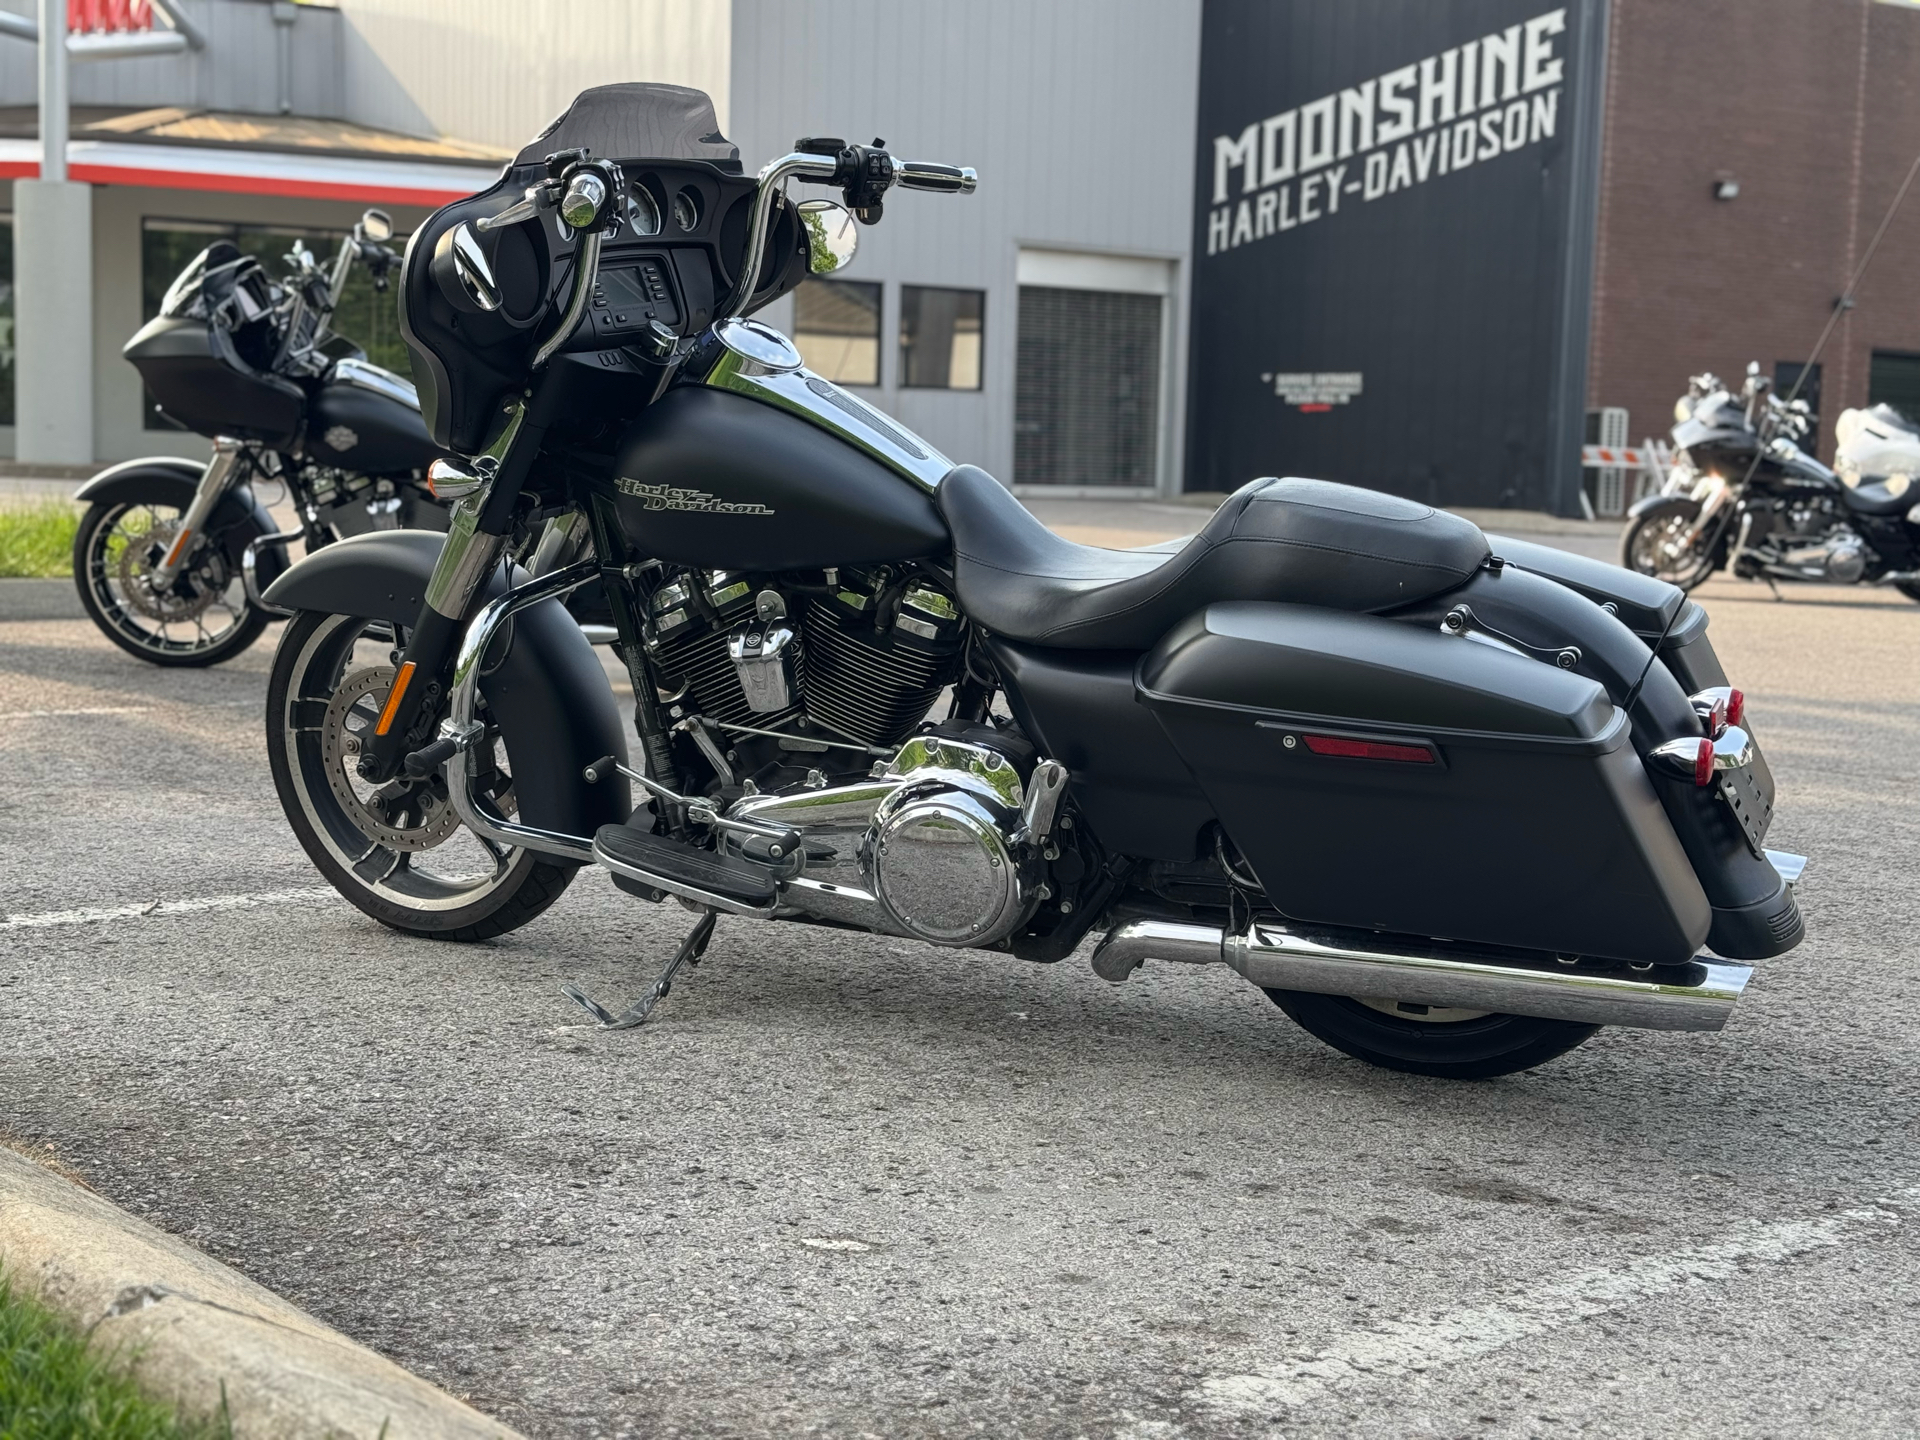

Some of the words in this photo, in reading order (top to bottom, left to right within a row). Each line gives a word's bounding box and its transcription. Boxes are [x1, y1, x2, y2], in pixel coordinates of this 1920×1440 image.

[1207, 88, 1560, 256] HARLEY-DAVIDSON
[1212, 7, 1567, 204] MOONSHINE
[643, 495, 776, 515] Davidson
